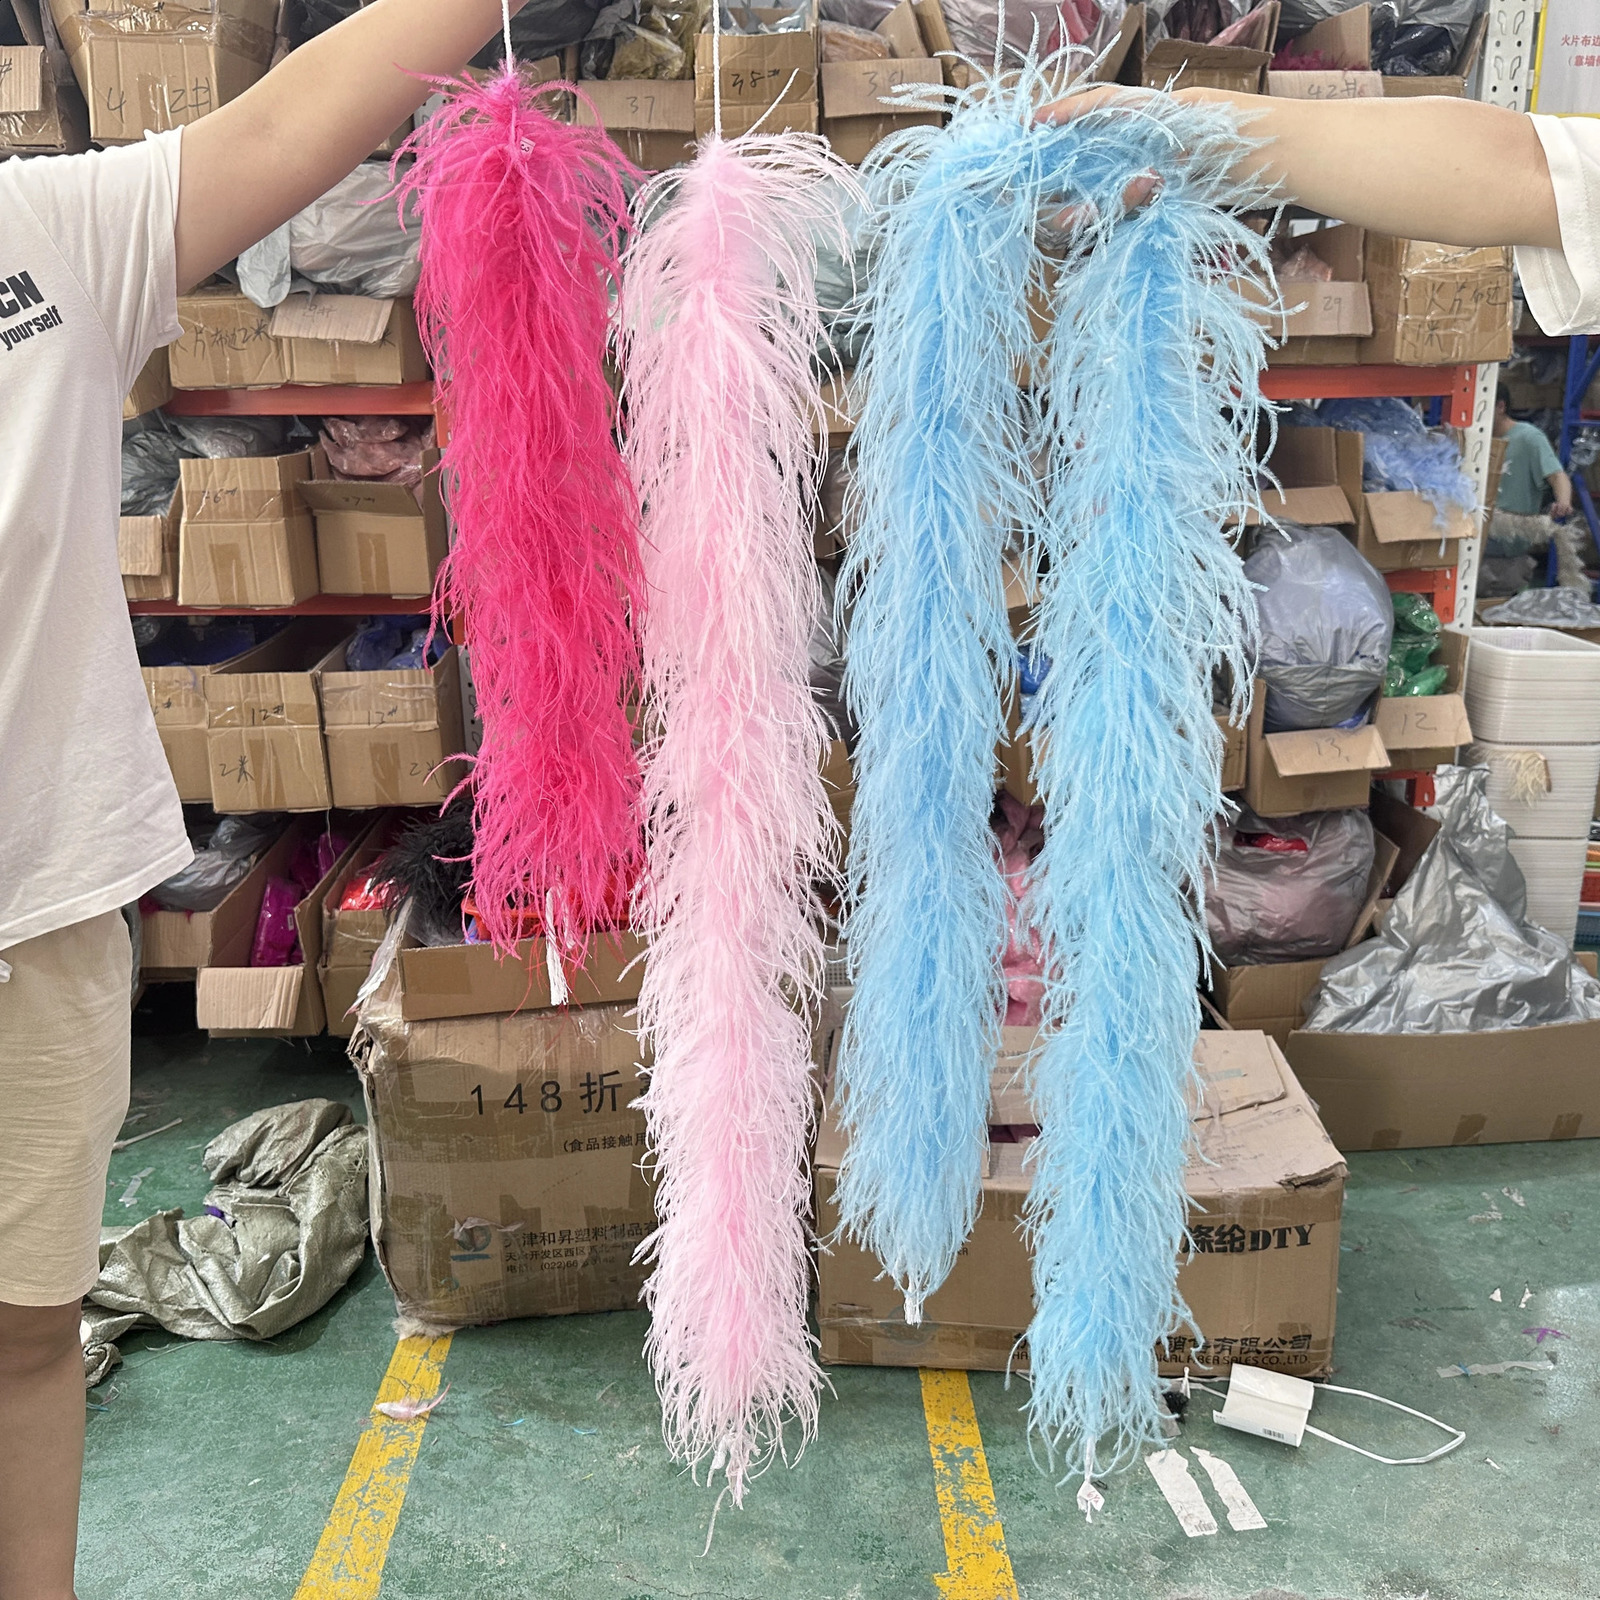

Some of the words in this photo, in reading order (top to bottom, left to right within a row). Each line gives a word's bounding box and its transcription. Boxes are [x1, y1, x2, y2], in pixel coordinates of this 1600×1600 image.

[0, 305, 63, 351] yourself
[251, 703, 285, 727] 12#
[367, 705, 398, 729] 13#
[1402, 712, 1438, 735] 12
[563, 1132, 656, 1153] （食品接触用
